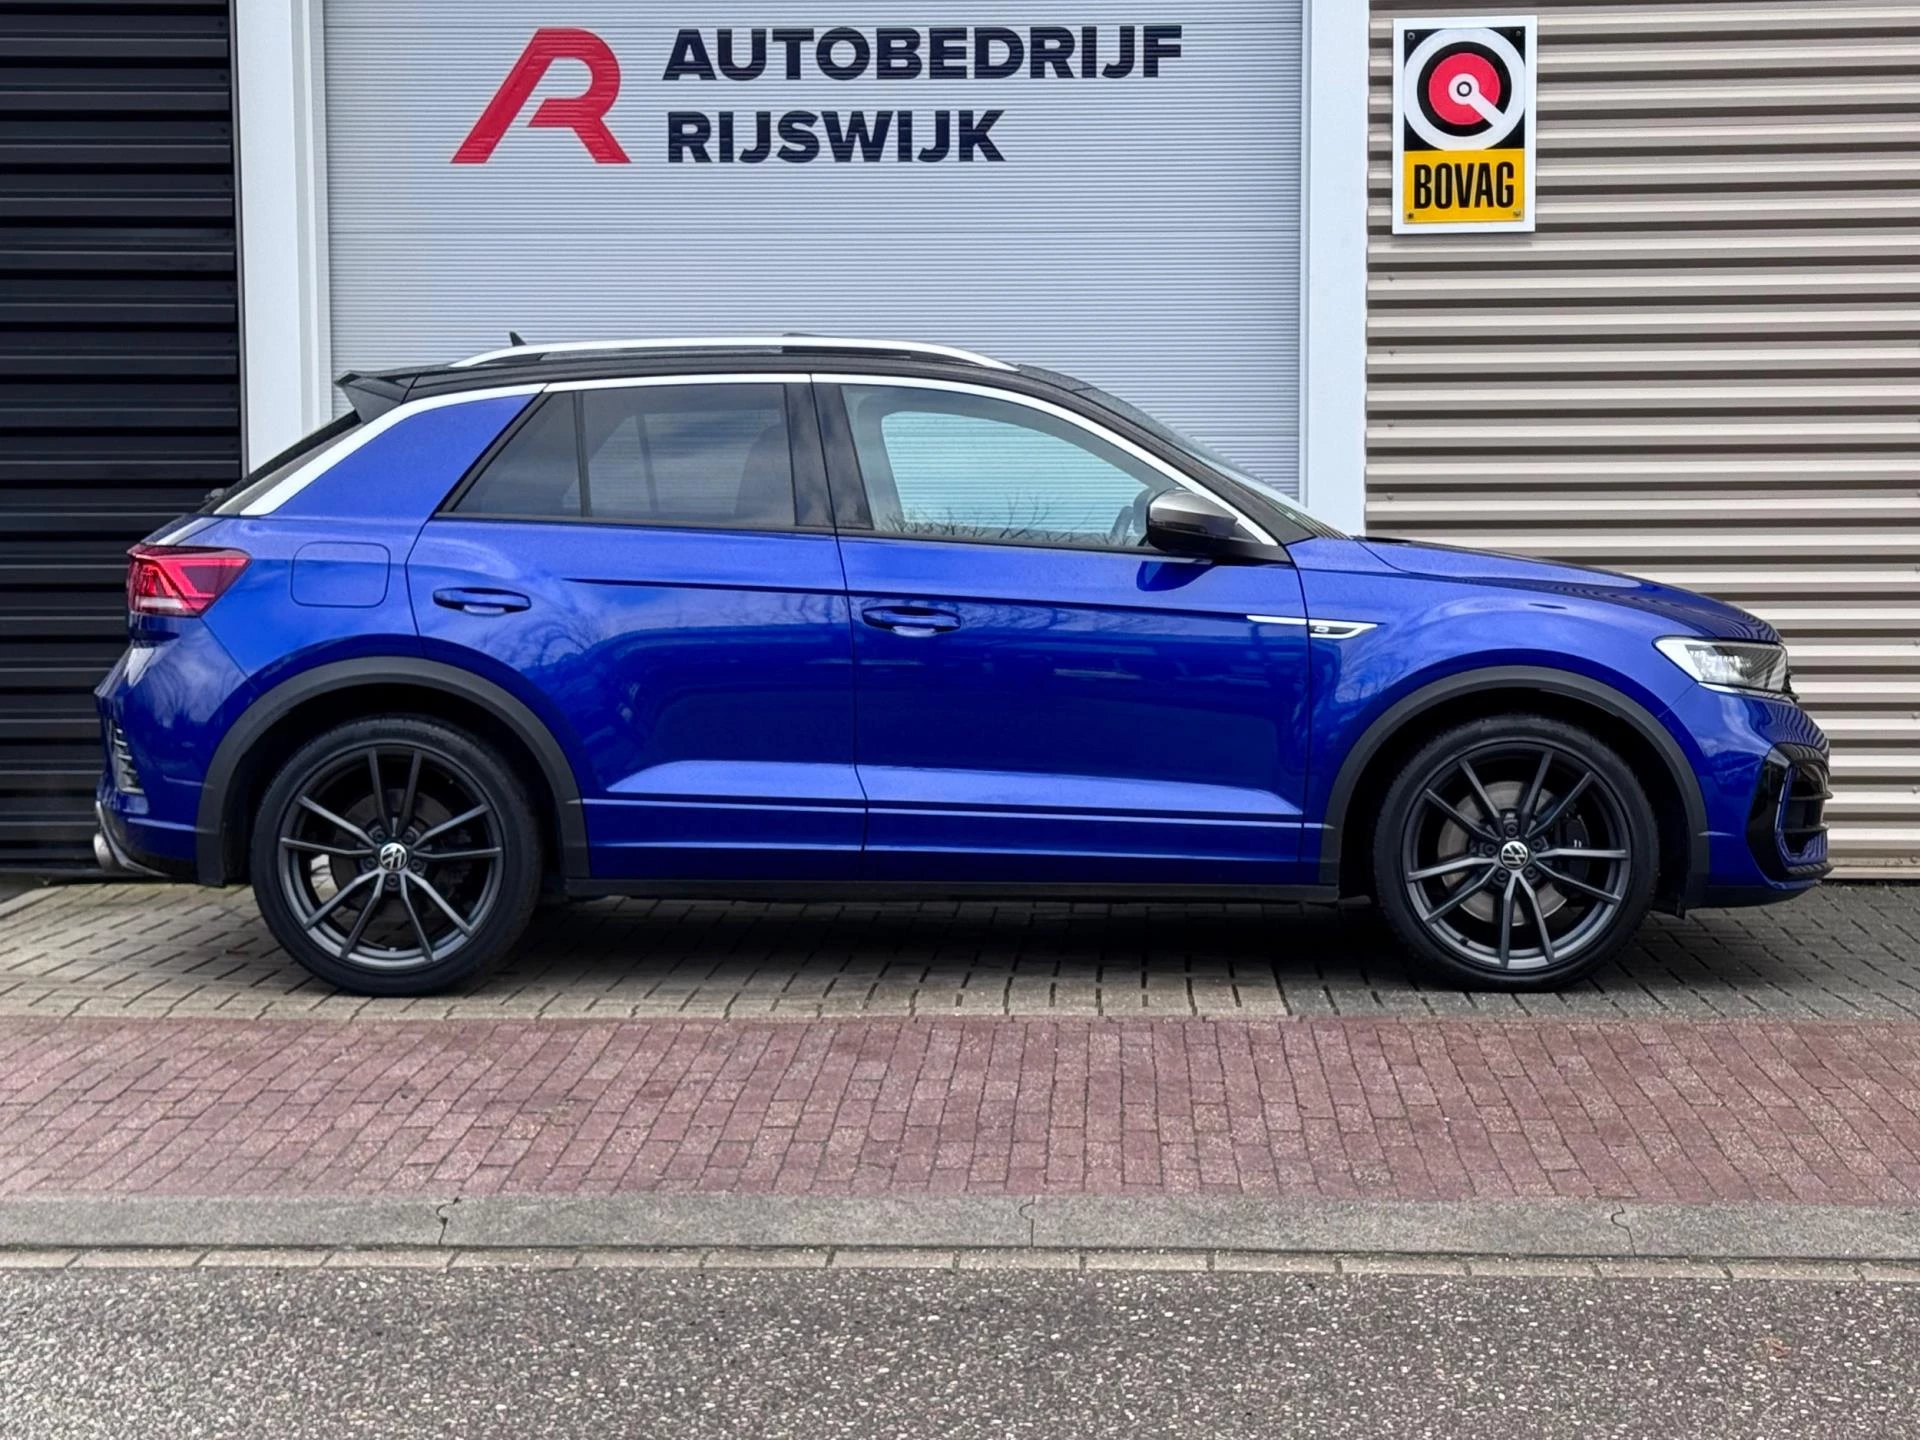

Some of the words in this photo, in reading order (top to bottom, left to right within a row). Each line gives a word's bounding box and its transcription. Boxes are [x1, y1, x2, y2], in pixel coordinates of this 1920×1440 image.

[662, 25, 1182, 81] AUTOBEDRIJF
[667, 110, 1006, 163] RIJSWIJK
[1414, 162, 1514, 209] BOVAG
